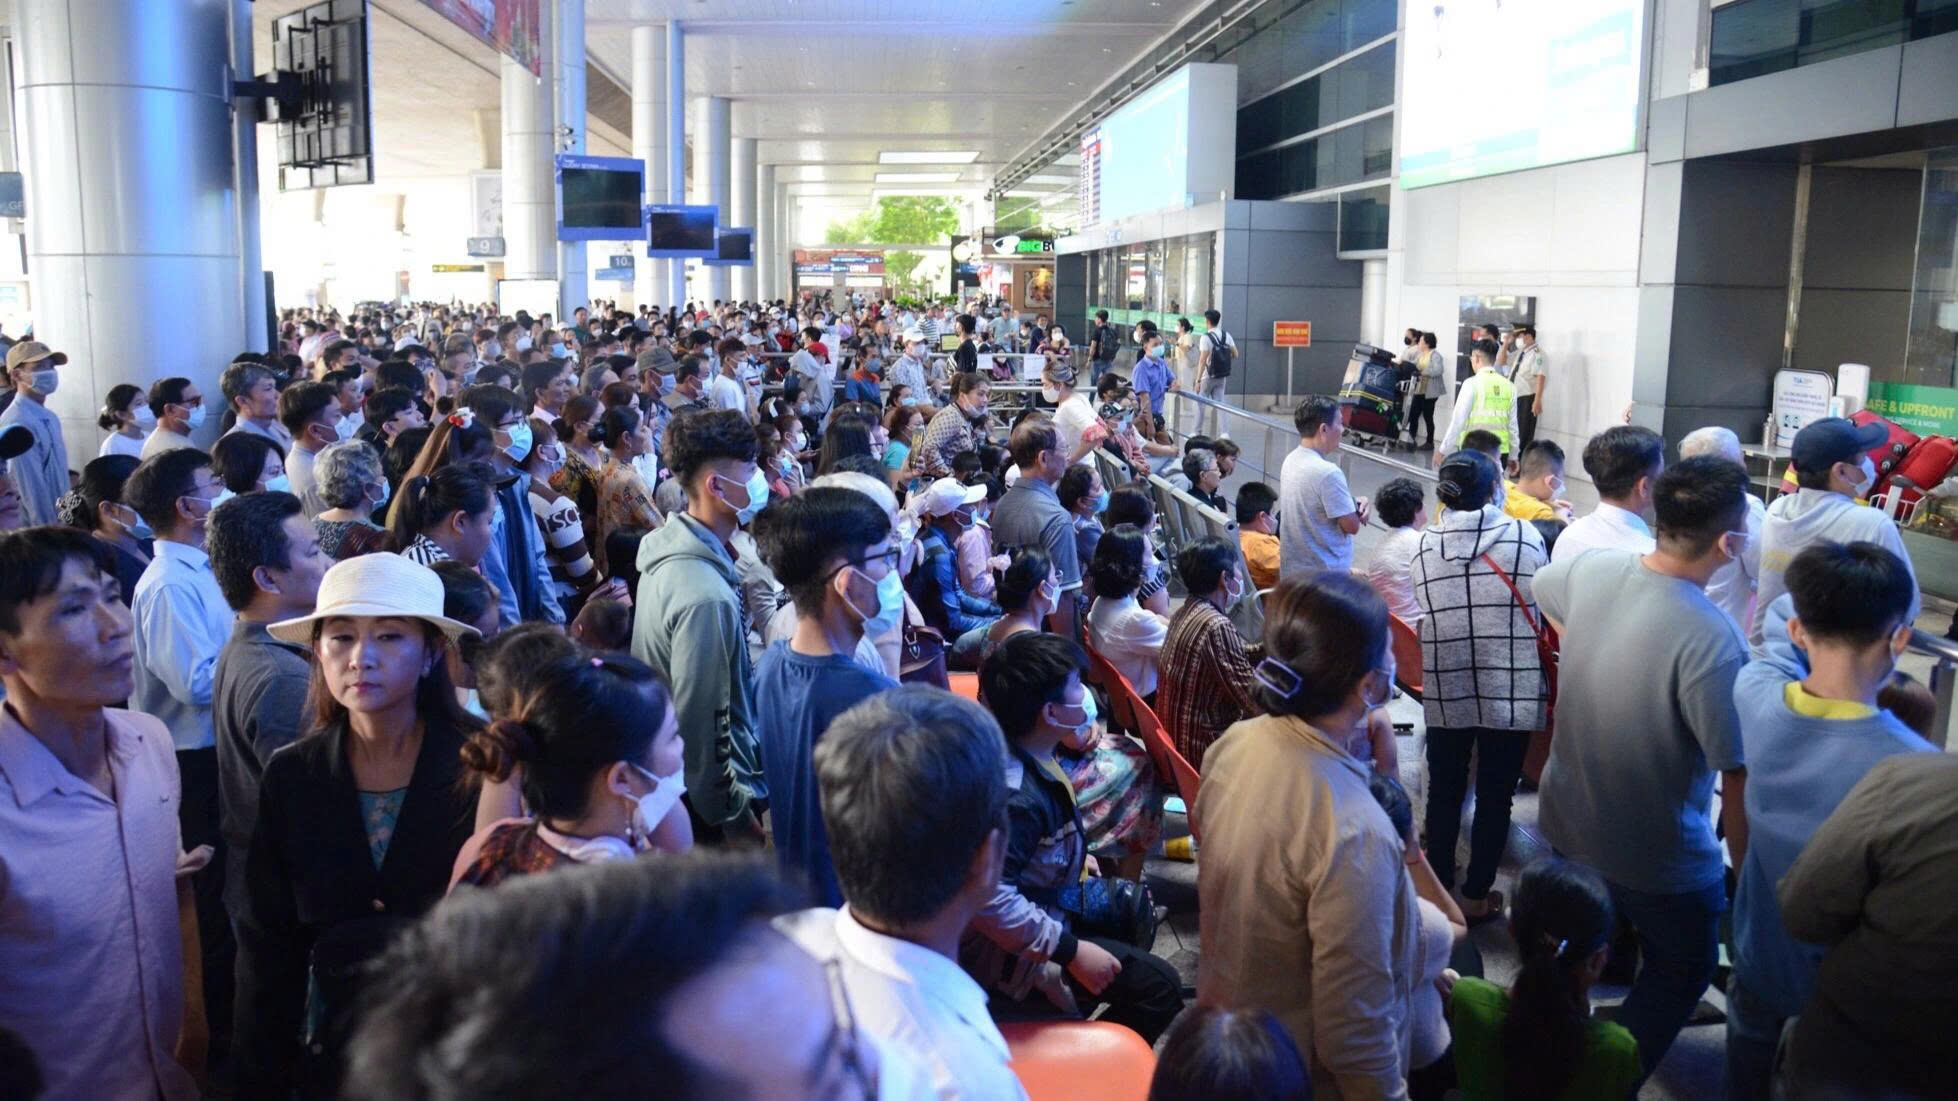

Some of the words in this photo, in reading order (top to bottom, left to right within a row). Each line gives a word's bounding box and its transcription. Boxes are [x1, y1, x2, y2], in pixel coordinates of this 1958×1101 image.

[480, 239, 490, 254] 9
[615, 256, 628, 266] 10
[1866, 399, 1888, 412] AFE
[1889, 401, 1897, 413] &
[1899, 401, 1955, 420] UPFRONT
